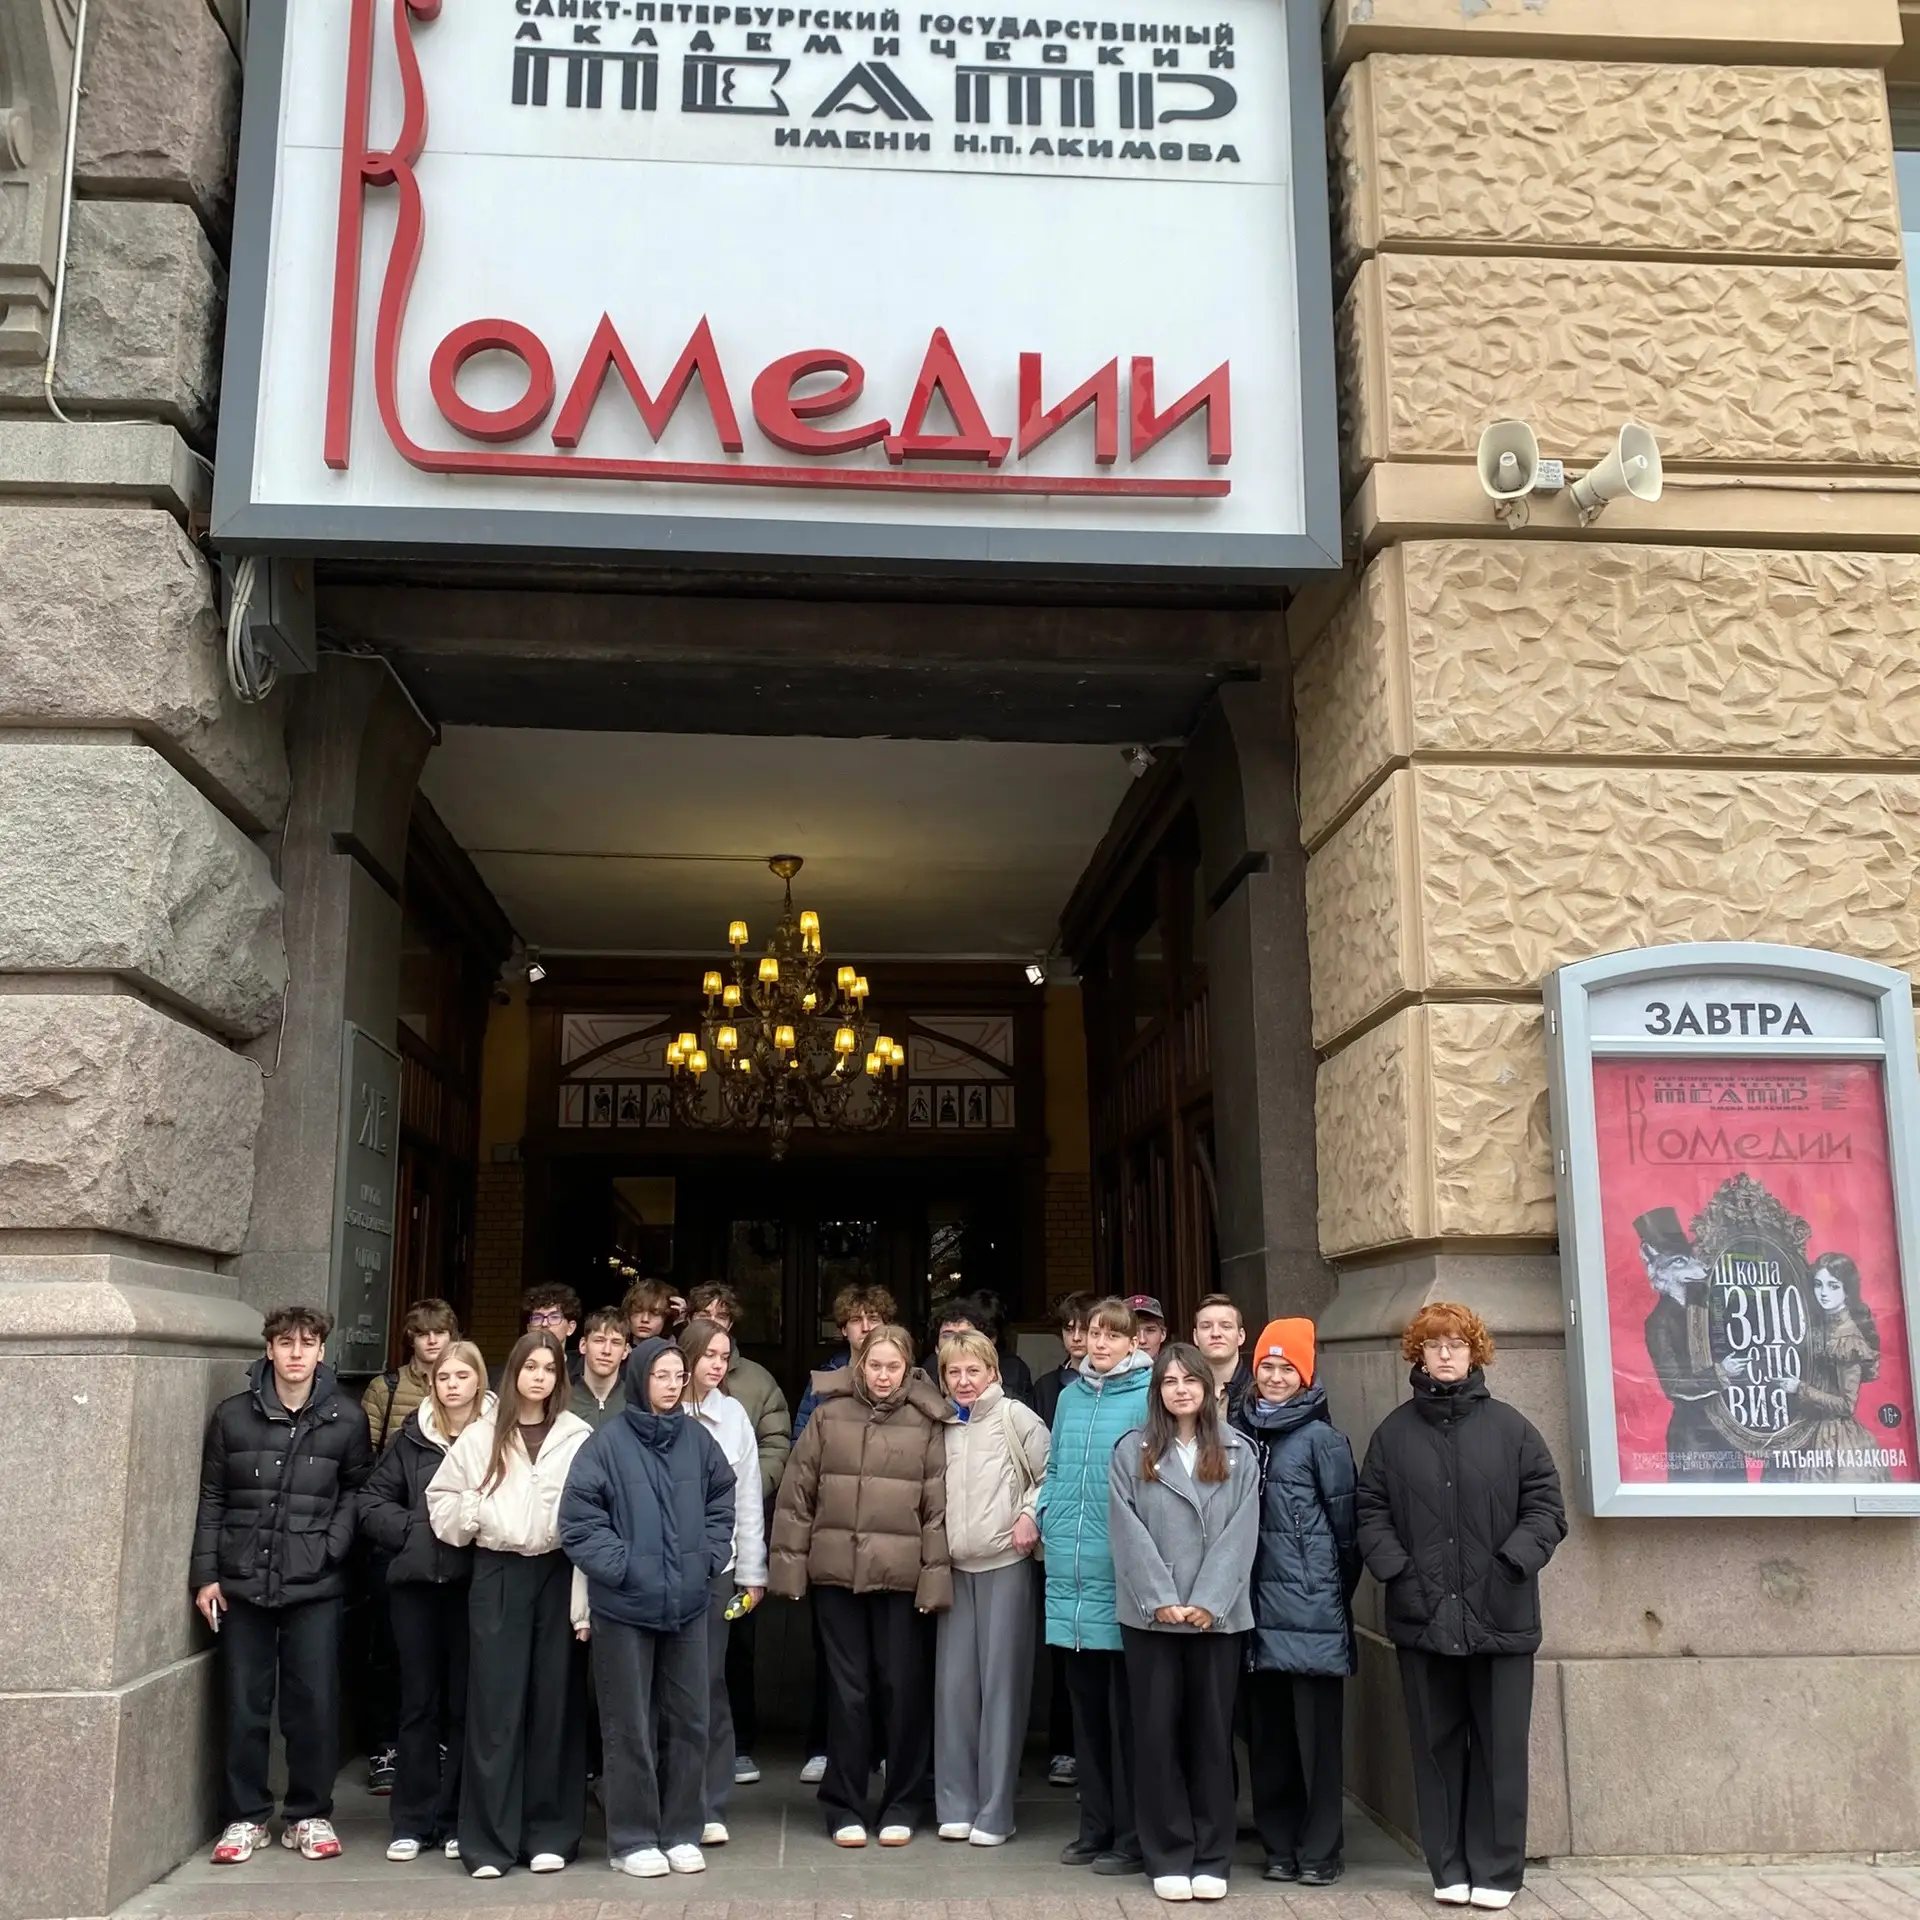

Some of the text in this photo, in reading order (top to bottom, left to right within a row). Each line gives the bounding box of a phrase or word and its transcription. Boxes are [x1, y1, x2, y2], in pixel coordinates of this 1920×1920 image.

[515, 0, 1235, 46] САНКТ-ПЕТЕРБУРГСКИЙ ГОСУДАРСТВЕННЫЙ
[515, 21, 1235, 69] АКАДЕМИЧЕСКИЙ
[511, 46, 1238, 130] ТЕАТР
[774, 127, 931, 151] ИМЕНИ
[1645, 1001, 1814, 1036] ЗАВТРА
[1714, 1253, 1783, 1286] Школа
[1724, 1285, 1807, 1350] ЗЛО
[1727, 1384, 1791, 1431] ВИЯ
[1882, 1407, 1899, 1424] 16+
[1773, 1448, 1908, 1469] ТАТЬЯНА КАЗАКОВА
